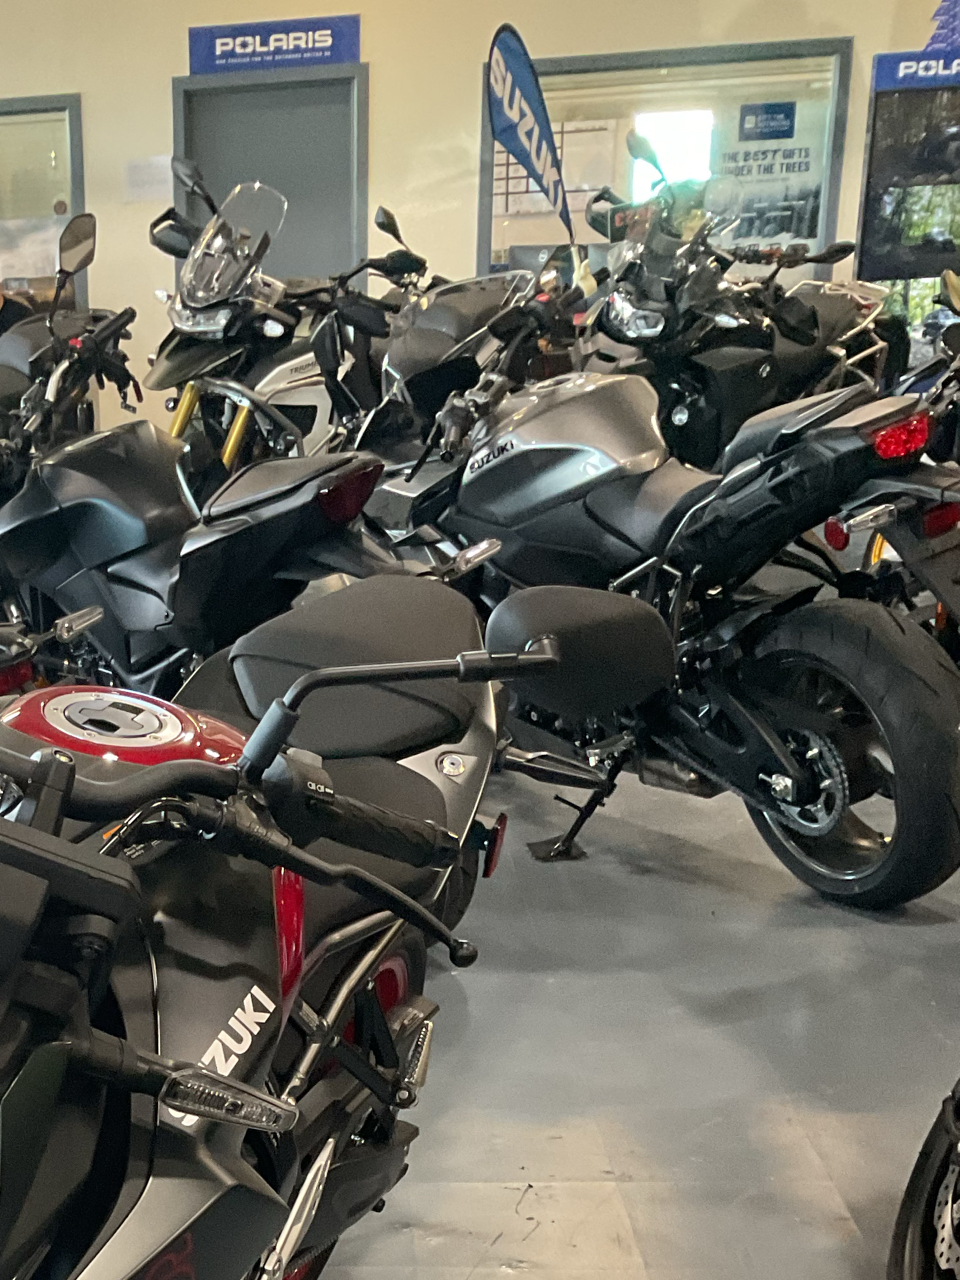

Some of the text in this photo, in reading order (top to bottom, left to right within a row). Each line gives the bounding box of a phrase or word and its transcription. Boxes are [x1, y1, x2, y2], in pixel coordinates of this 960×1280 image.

[216, 30, 333, 55] POLARIS
[490, 46, 563, 214] SUZUKI
[722, 147, 810, 164] THE BEST GIFTS
[757, 163, 775, 174] THE
[780, 161, 810, 173] TREES
[470, 440, 514, 474] SUZUKI
